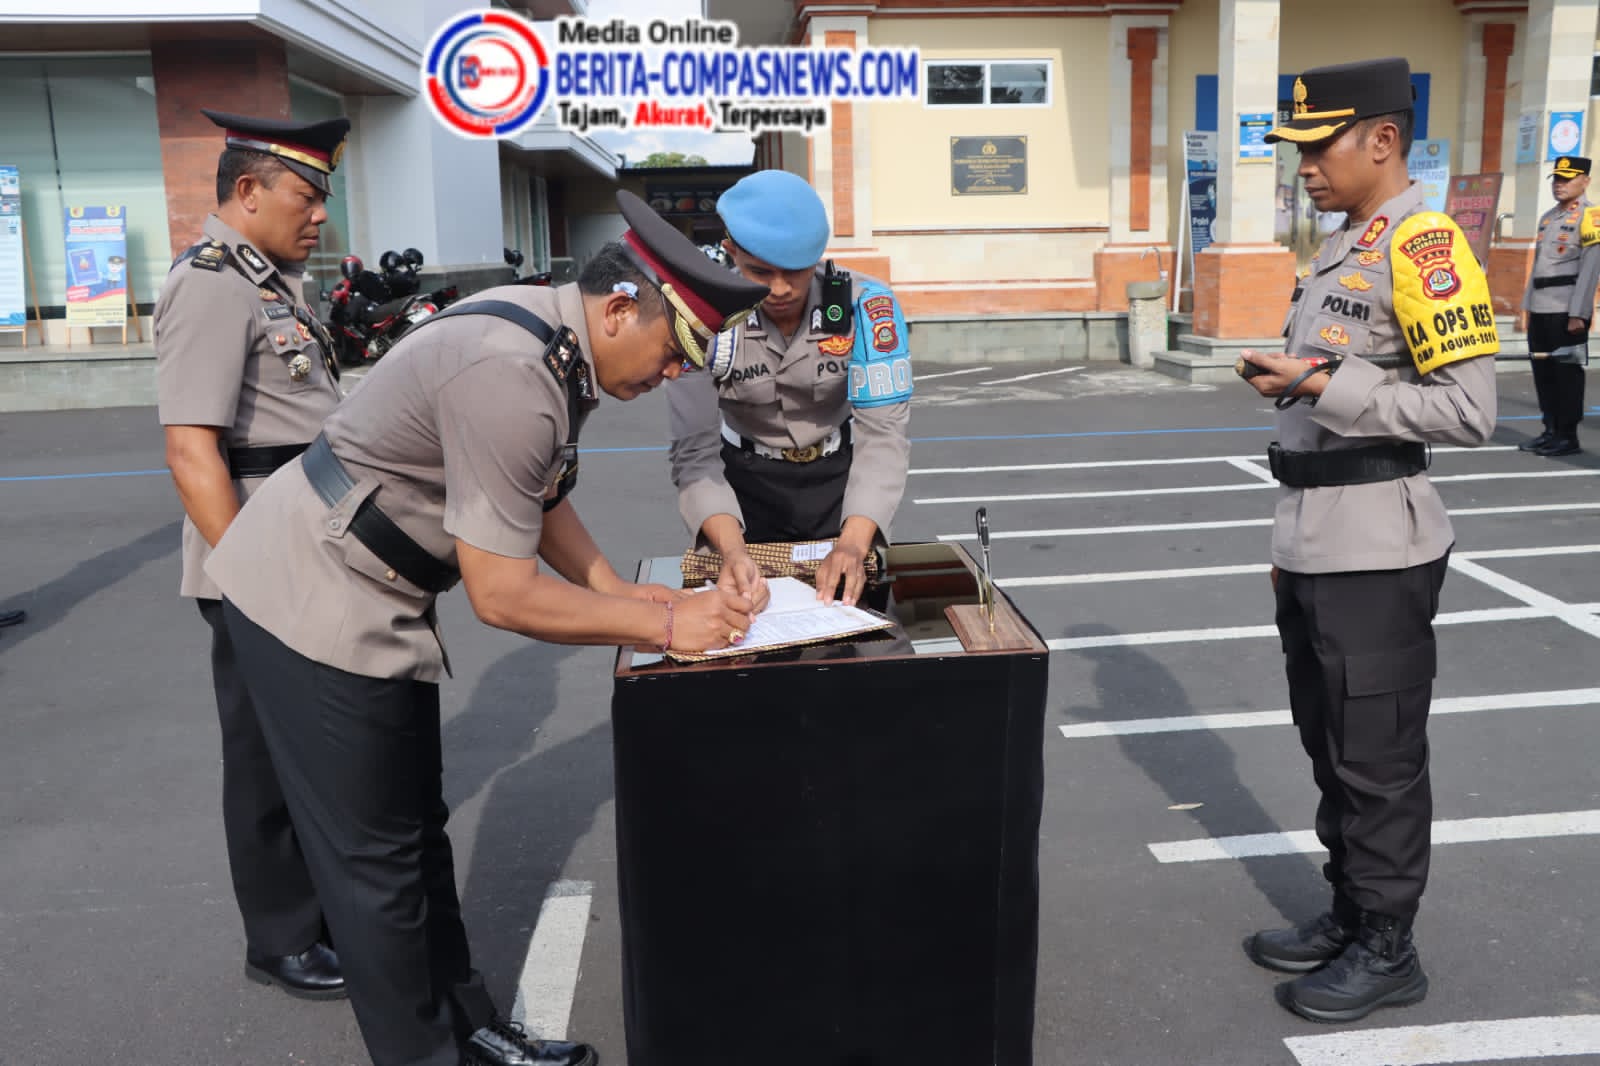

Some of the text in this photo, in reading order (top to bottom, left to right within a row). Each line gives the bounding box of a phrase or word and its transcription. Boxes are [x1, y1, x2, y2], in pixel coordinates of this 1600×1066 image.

[1321, 295, 1370, 321] POLRI
[1407, 303, 1493, 349] KA OPS RES
[731, 362, 770, 381] DANA
